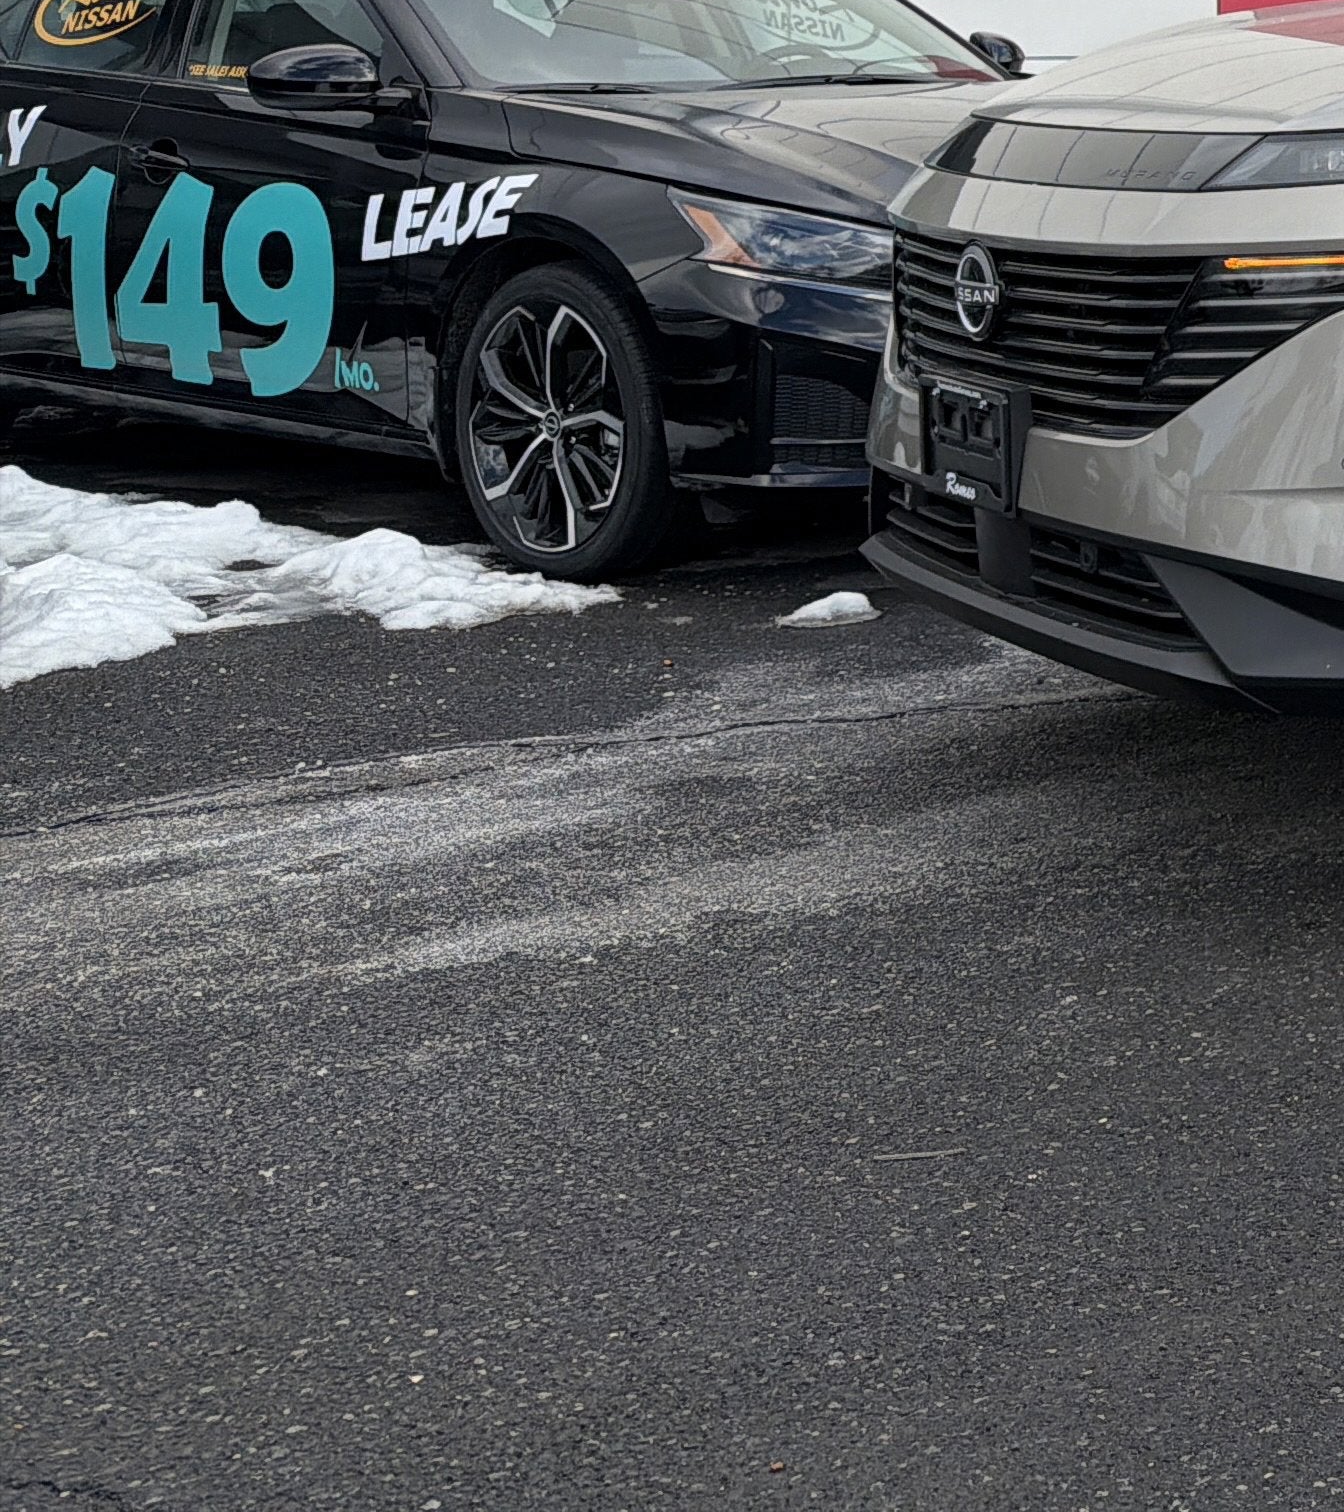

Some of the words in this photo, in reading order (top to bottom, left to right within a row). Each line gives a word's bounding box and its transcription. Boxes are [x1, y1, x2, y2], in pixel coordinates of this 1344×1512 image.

[361, 173, 540, 263] LEASE
[13, 165, 335, 397] $149
[957, 286, 995, 303] SSAN
